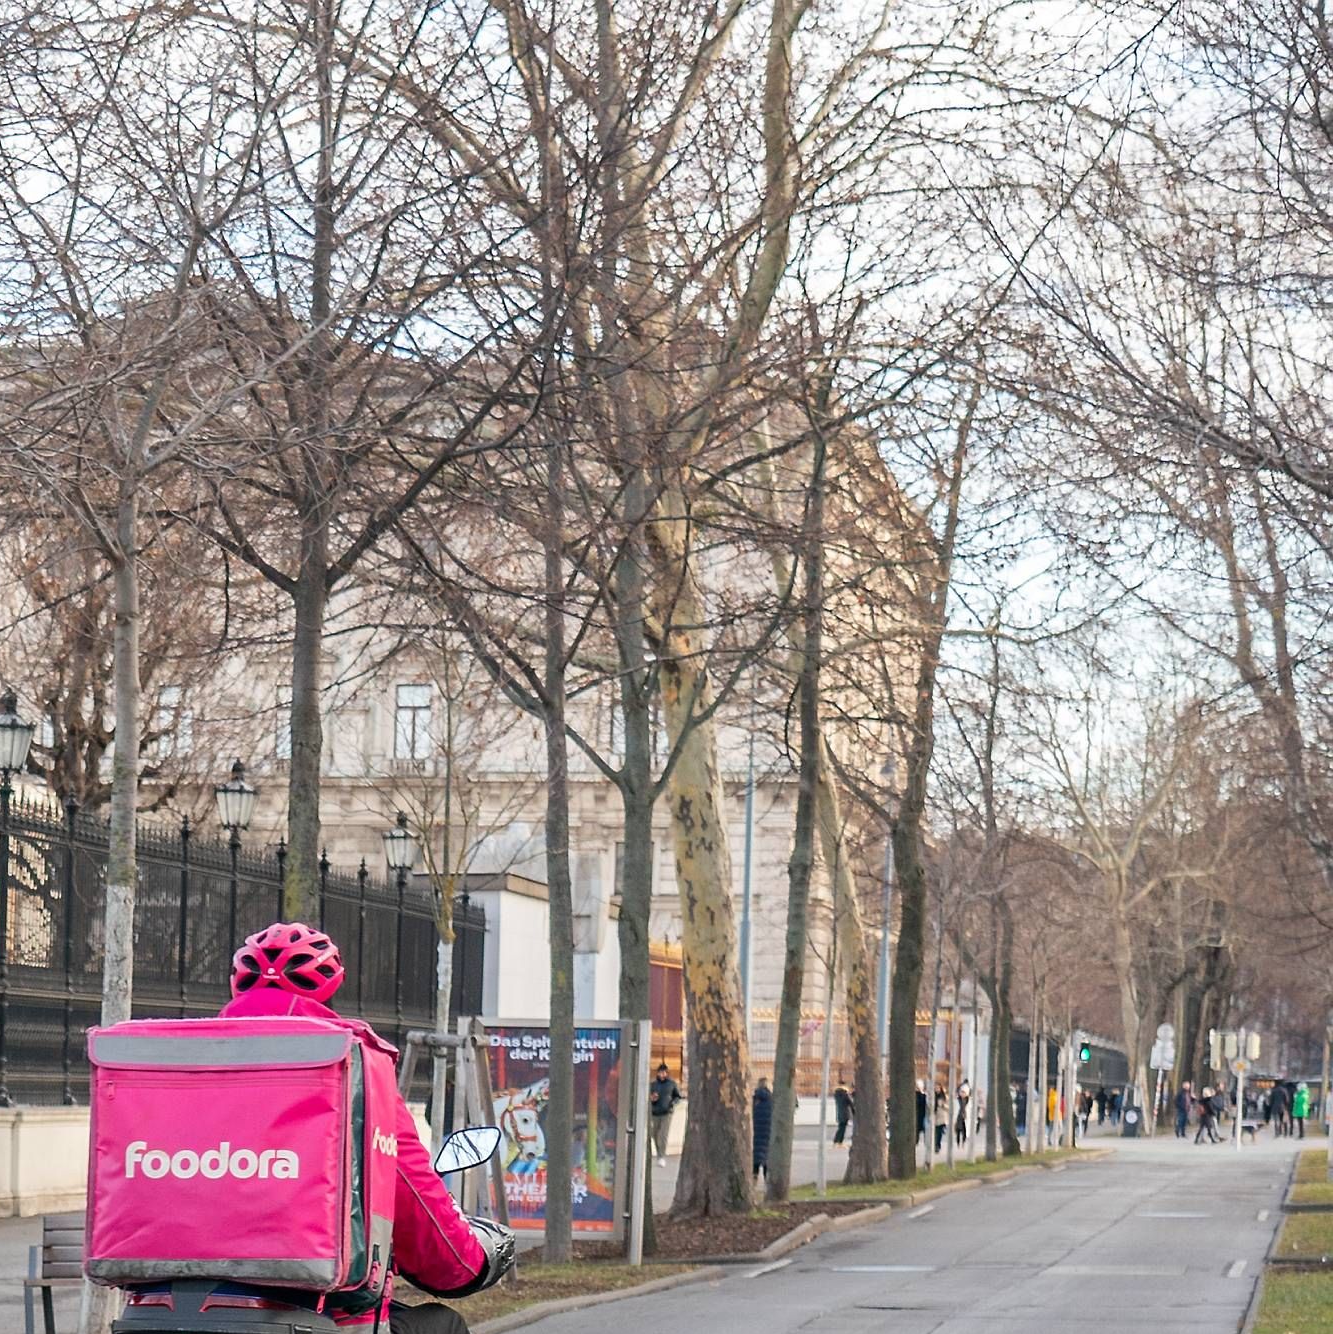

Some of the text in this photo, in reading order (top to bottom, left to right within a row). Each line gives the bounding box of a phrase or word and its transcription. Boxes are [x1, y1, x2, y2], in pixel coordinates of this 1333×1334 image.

[490, 1034, 521, 1047] Das
[509, 1048, 537, 1060] der
[125, 1140, 300, 1179] foodora
